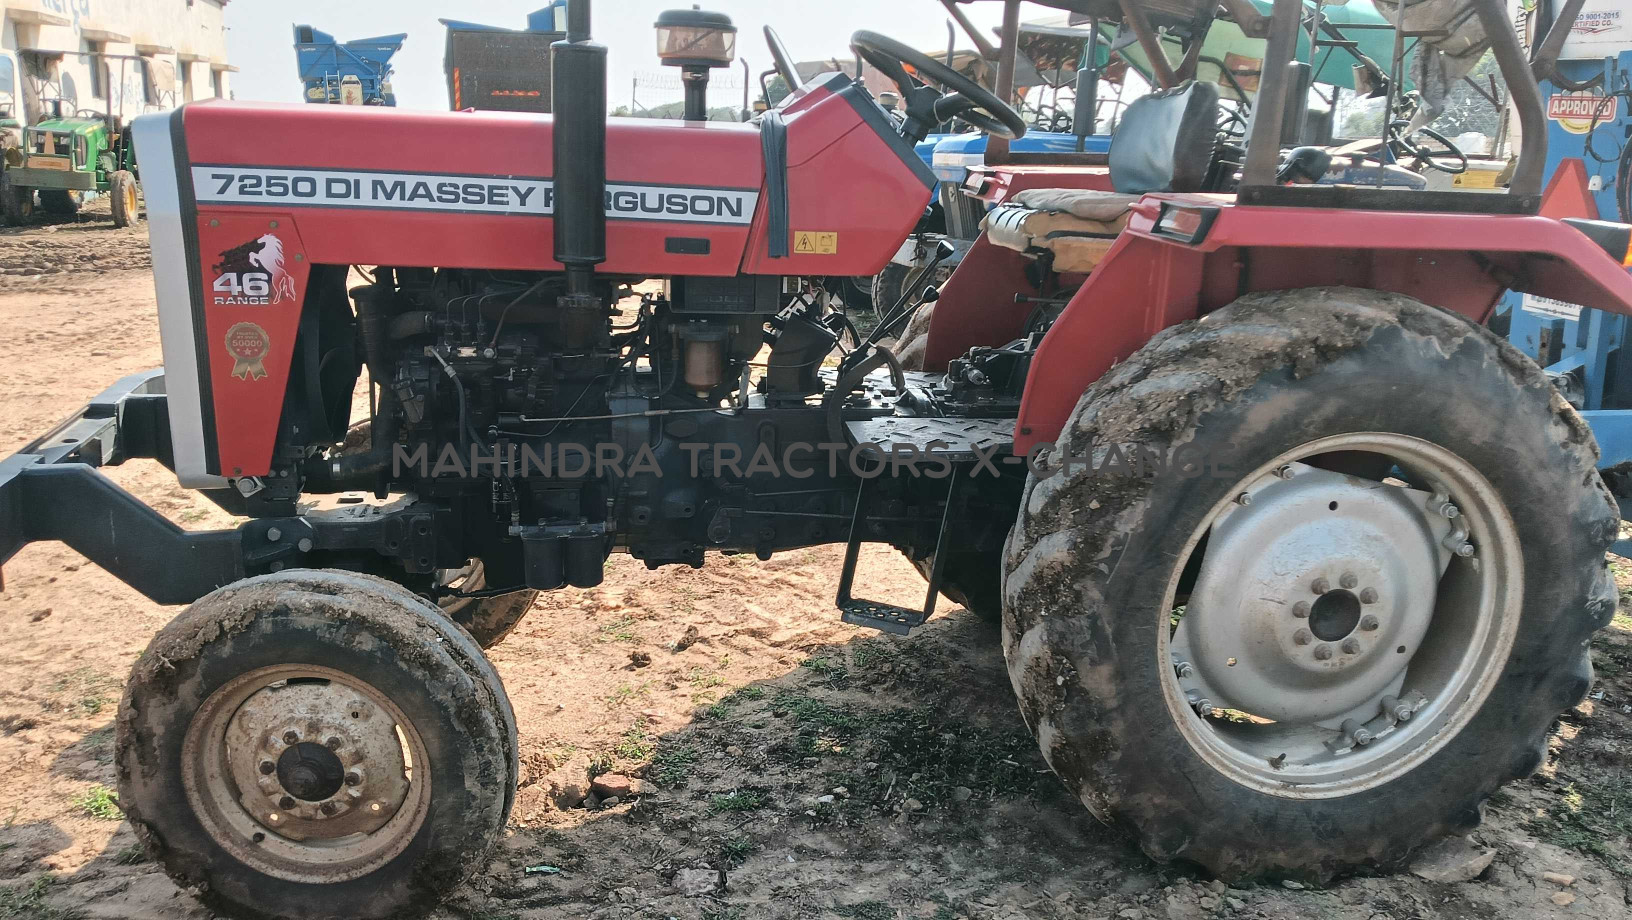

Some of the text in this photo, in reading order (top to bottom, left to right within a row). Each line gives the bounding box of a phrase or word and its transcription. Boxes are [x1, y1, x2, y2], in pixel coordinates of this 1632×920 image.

[210, 173, 743, 218] 7250 DI MASSEY FGUSON
[213, 272, 269, 296] 46
[214, 297, 269, 305] RANGE
[232, 339, 263, 347] 50000
